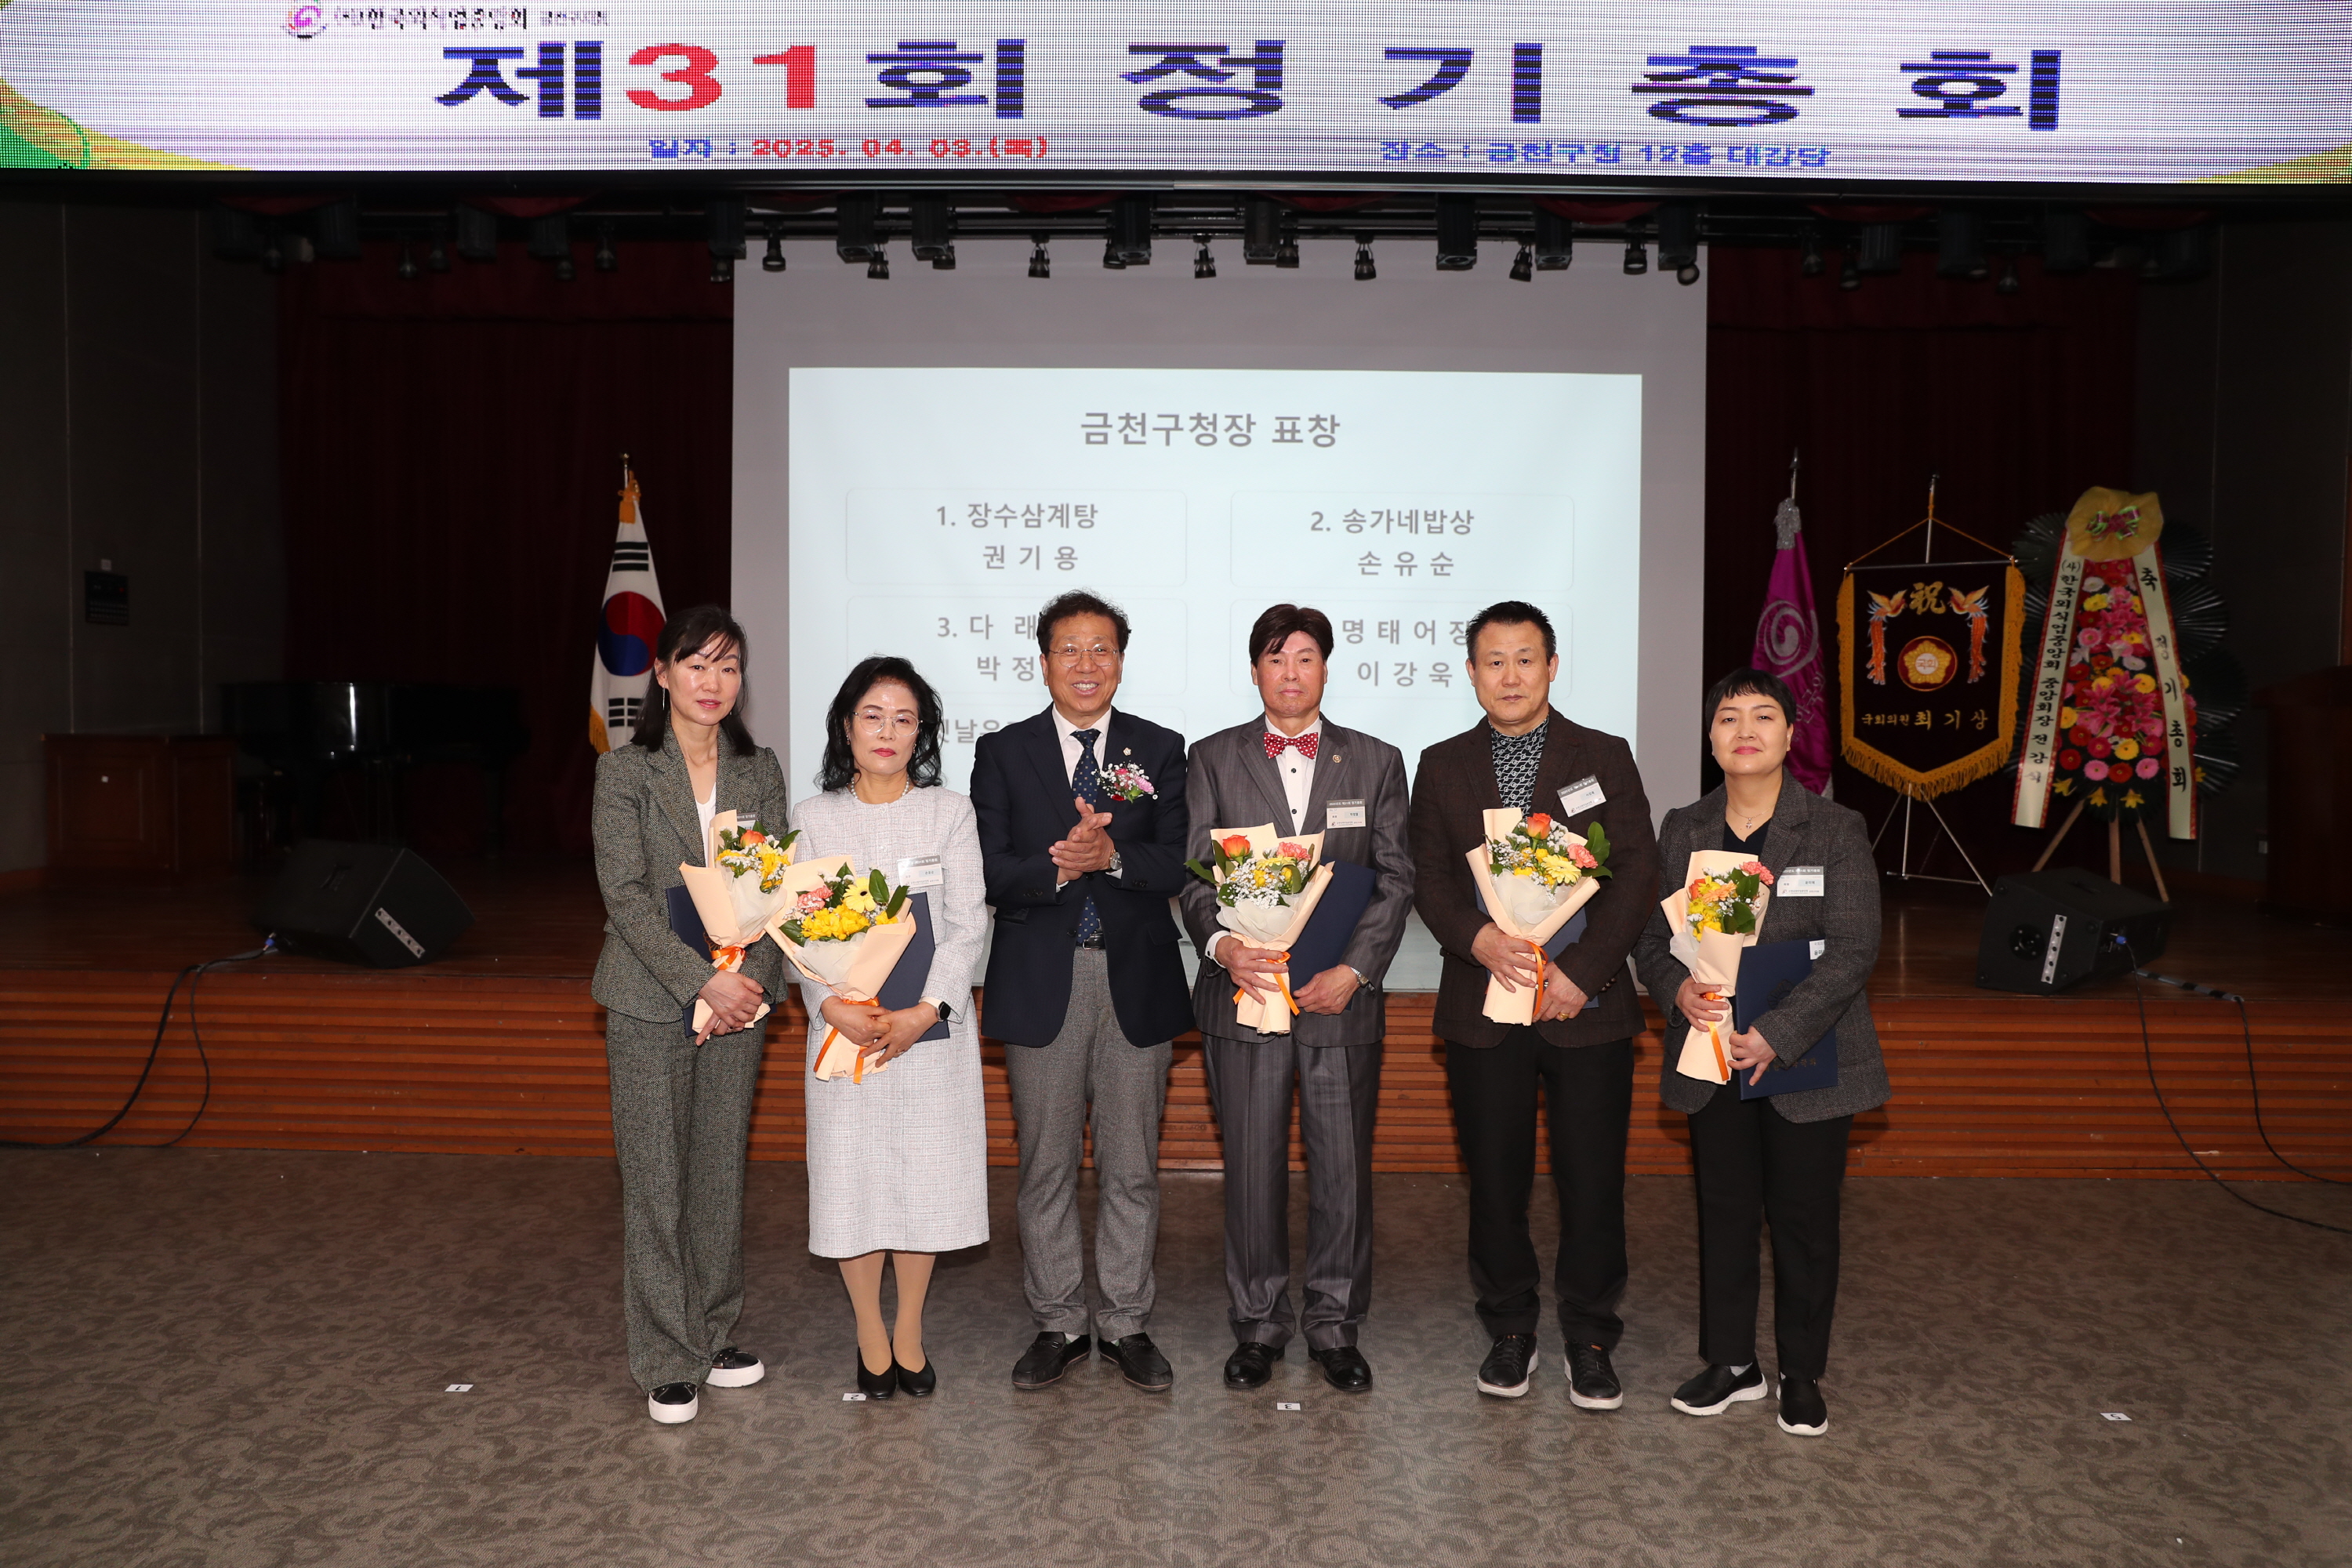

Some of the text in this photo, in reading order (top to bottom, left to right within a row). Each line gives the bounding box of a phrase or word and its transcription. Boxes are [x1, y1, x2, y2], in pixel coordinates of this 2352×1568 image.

[1081, 412, 1341, 448] 금천구청장 표창
[937, 503, 1098, 528] 1. 장수삼계탕
[1310, 509, 1475, 535] 2. 송가네밥상
[2140, 567, 2158, 592] 축
[1909, 581, 1947, 615] 祝
[937, 617, 957, 637] 3.
[1861, 713, 1910, 726] 국회의원
